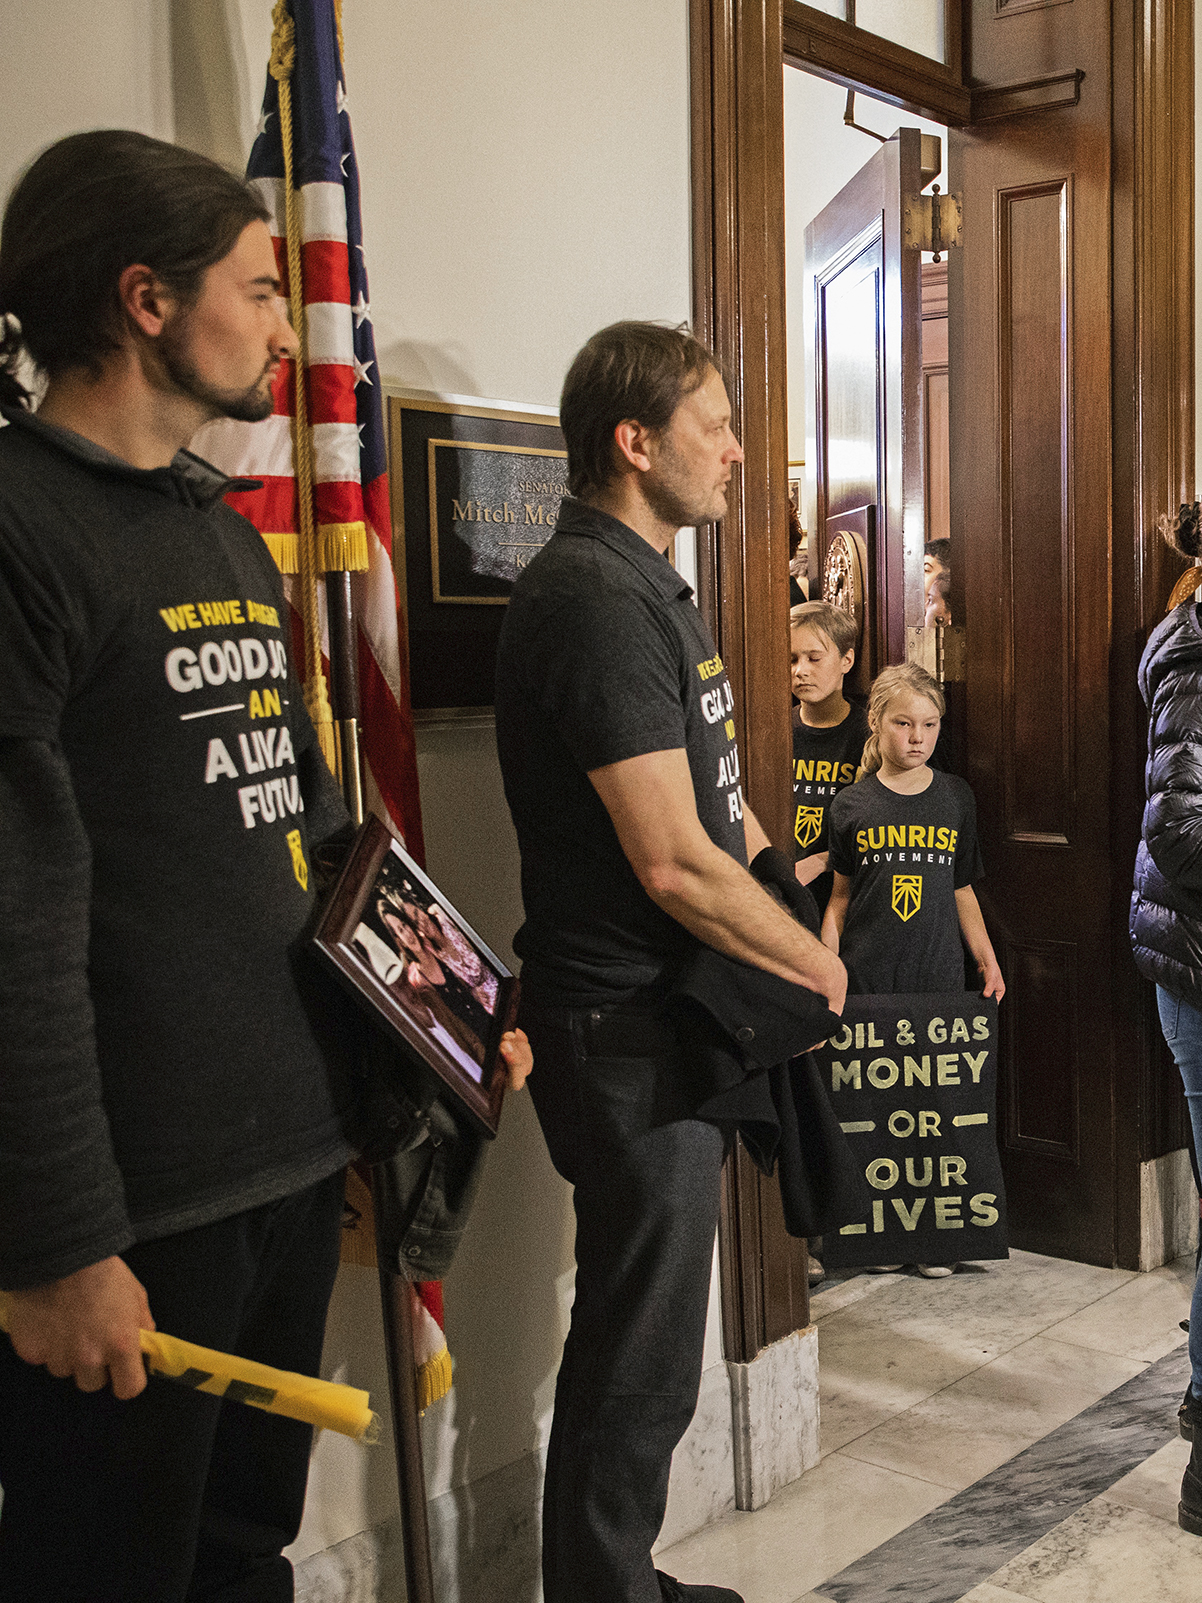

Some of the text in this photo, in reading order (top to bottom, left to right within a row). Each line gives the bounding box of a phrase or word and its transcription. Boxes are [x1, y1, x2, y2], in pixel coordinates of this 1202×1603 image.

[452, 499, 560, 526] Mitch Mc
[159, 603, 202, 633] WE
[196, 600, 246, 626] HAVE
[165, 638, 268, 693] GOOD
[205, 726, 295, 784] A LIVA
[238, 775, 304, 829] FUTU
[856, 825, 958, 853] SUNRISE
[829, 1016, 990, 1050] OIL & GAS
[831, 1050, 989, 1092] MONEY
[887, 1109, 942, 1138] OR
[865, 1155, 968, 1190] OUR
